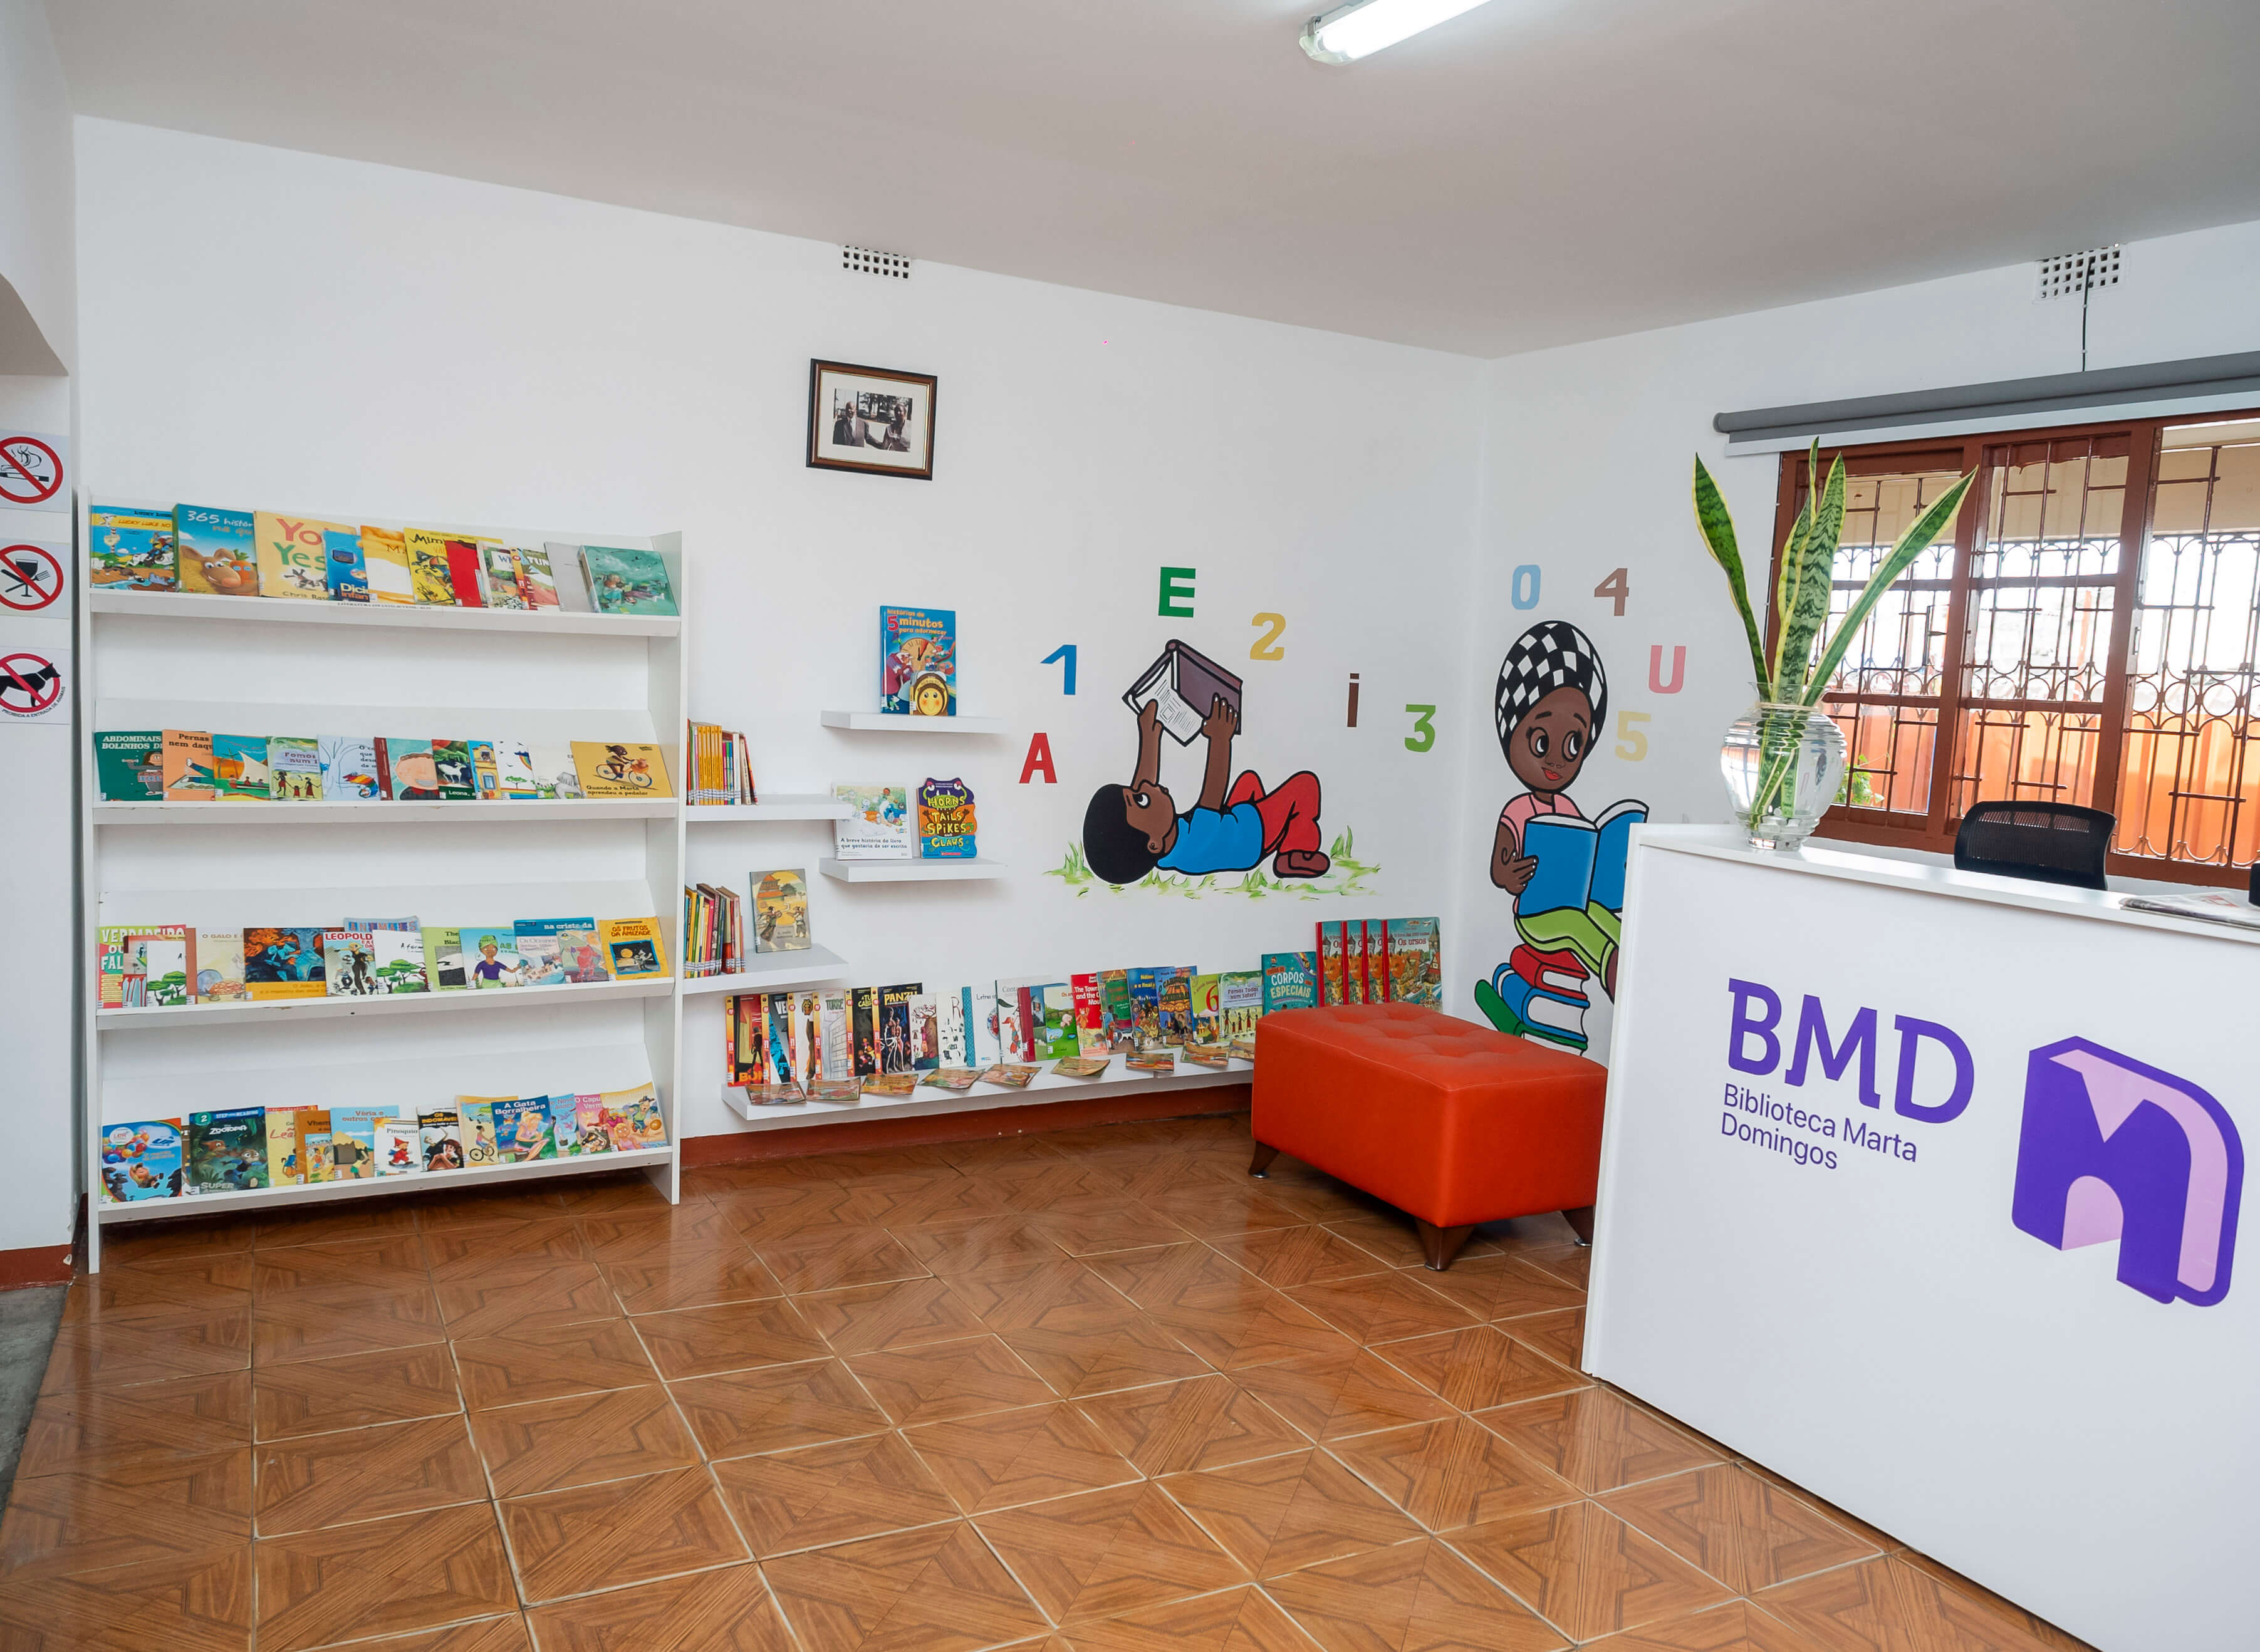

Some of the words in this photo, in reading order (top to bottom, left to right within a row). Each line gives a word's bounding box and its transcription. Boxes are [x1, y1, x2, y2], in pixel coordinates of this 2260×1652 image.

[188, 510, 219, 524] 365
[1158, 566, 1196, 618] E
[1594, 568, 1629, 616] 4
[887, 616, 899, 631] 5
[900, 616, 944, 628] minutos
[1249, 612, 1286, 661] 2
[1040, 644, 1077, 695] 1
[1648, 645, 1686, 694] U
[179, 734, 209, 742] Pernas
[1404, 704, 1436, 752] 3
[1615, 710, 1652, 762] 5
[1019, 732, 1058, 784] A
[927, 796, 966, 807] HORNS
[931, 837, 964, 848] CLAWS
[1270, 985, 1311, 998] ESPECIAIS
[1271, 971, 1304, 986] CORPOS
[1728, 977, 1975, 1124] BMD
[495, 1104, 546, 1115] Borralheira
[1724, 1083, 1836, 1138] Biblioteca
[1843, 1117, 1917, 1163] Marta
[1721, 1111, 1838, 1170] Domingos
